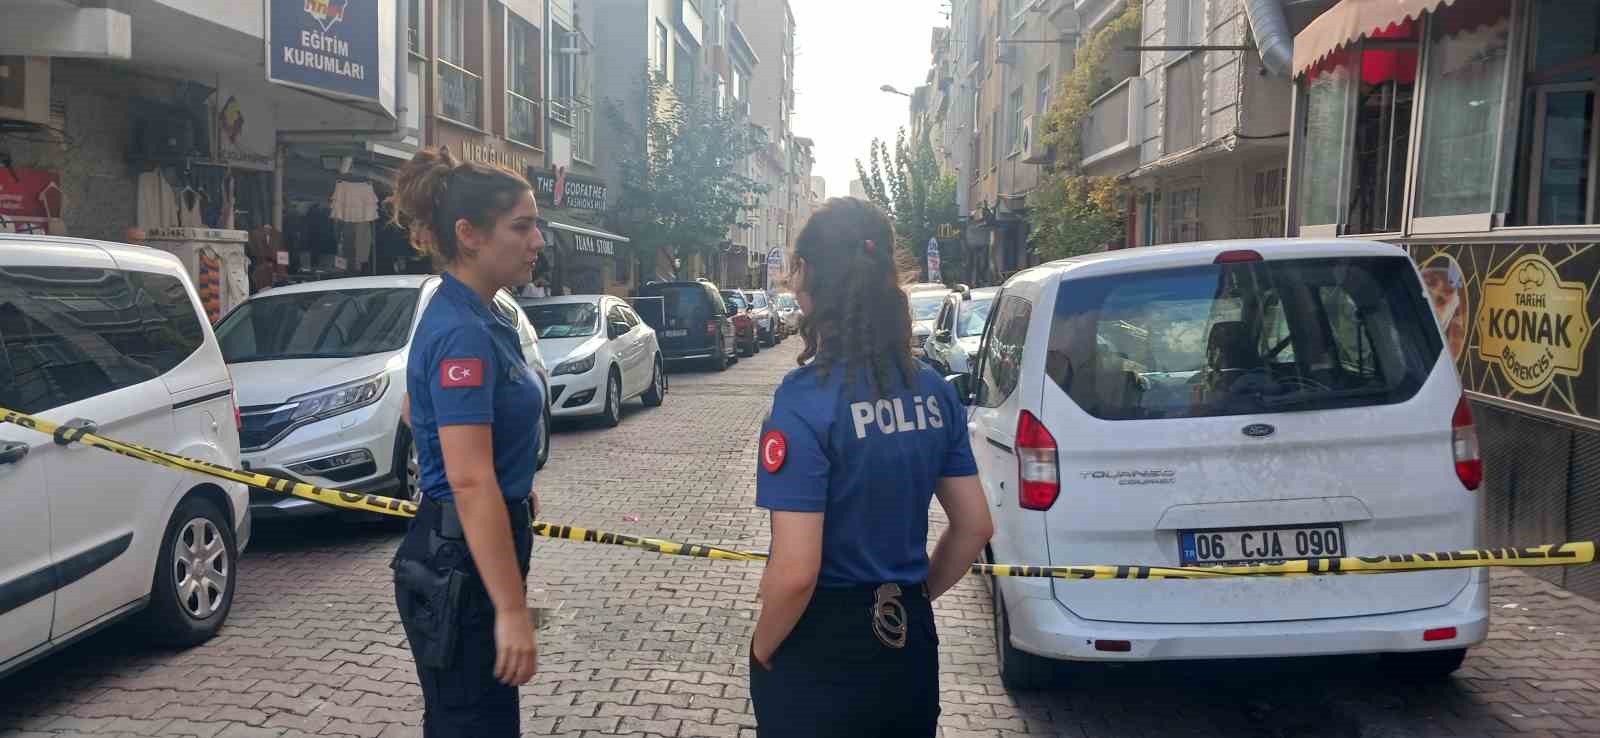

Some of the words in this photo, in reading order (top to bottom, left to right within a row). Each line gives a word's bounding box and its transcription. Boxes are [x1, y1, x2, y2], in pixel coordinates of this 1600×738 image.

[302, 30, 348, 57] EĞİTİM
[283, 46, 365, 80] KURUMLARI
[537, 176, 554, 193] THE
[565, 181, 608, 201] GODFATHER
[1489, 308, 1572, 348] KONAK
[850, 395, 943, 439] POLİS
[1197, 534, 1225, 559] 06
[1241, 531, 1284, 558] CJA
[1295, 529, 1339, 556] 090
